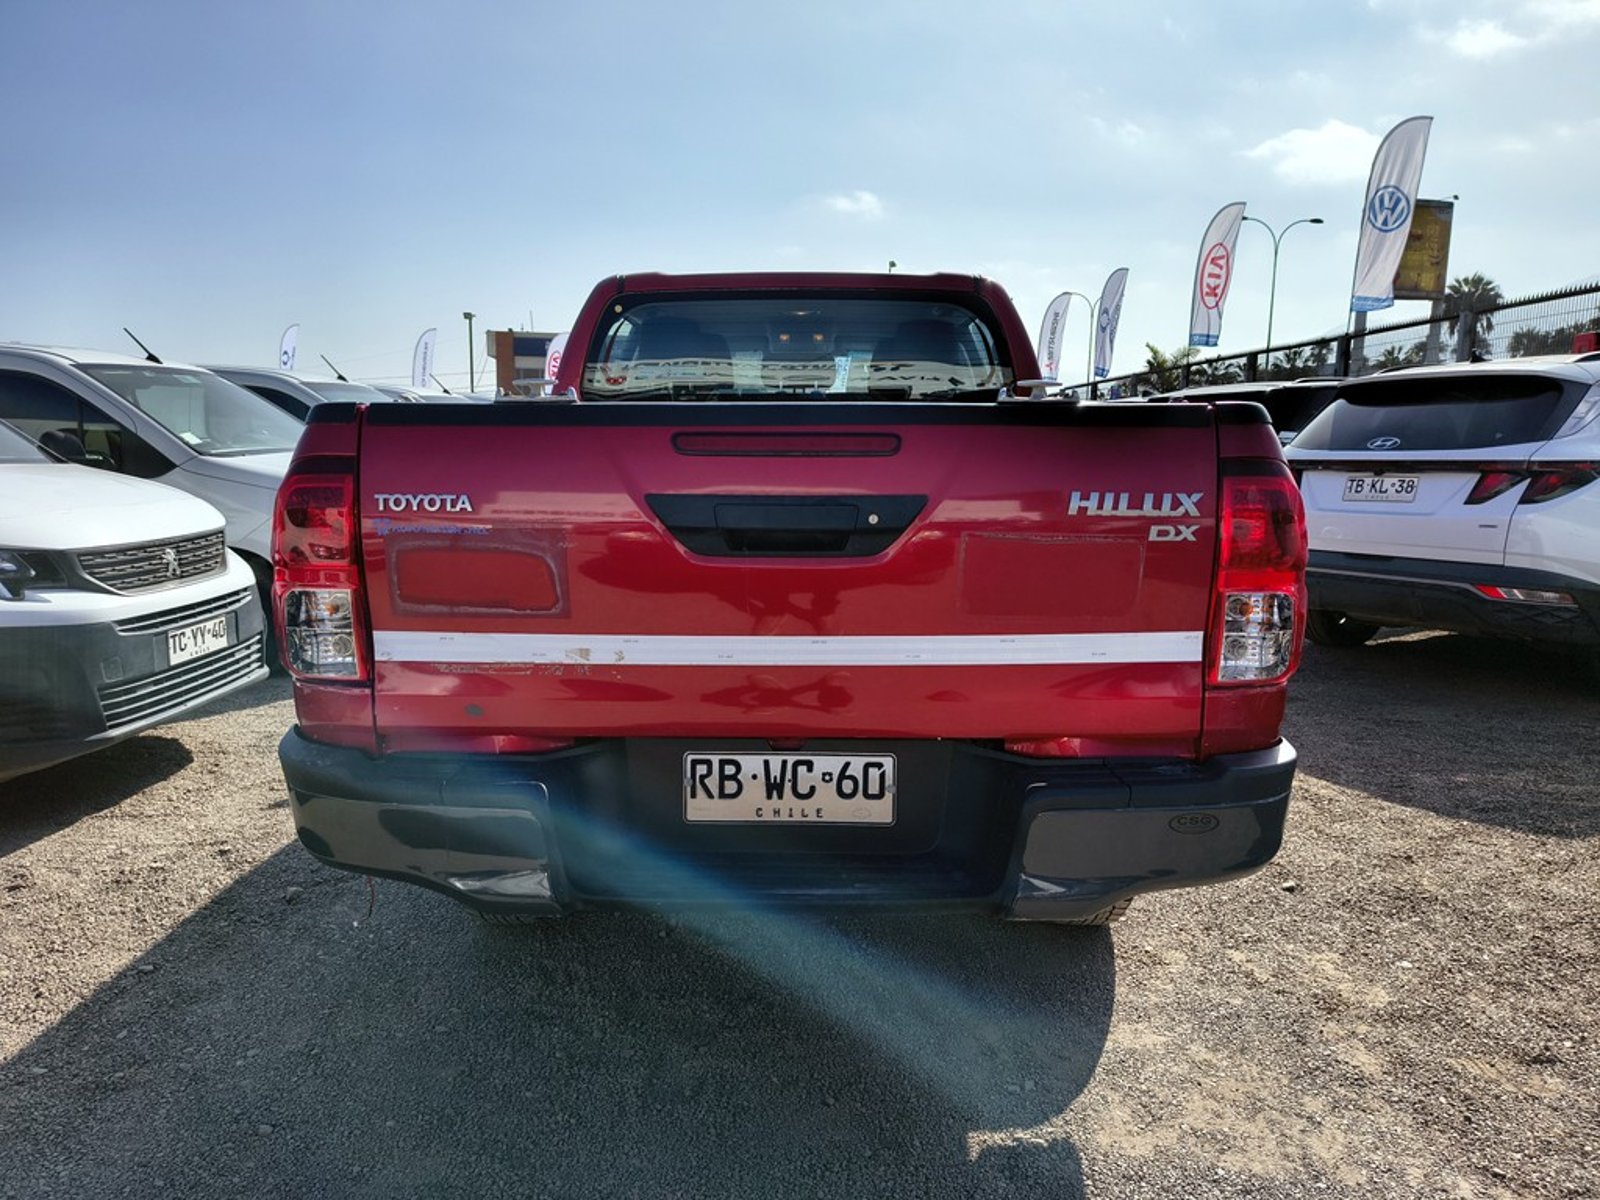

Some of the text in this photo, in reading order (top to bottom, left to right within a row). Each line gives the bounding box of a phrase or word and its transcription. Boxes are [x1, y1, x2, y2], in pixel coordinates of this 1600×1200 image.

[1205, 254, 1226, 298] KIA
[374, 494, 473, 512] TOYOTA
[1067, 491, 1204, 517] HILUX
[1148, 525, 1201, 542] DX
[755, 807, 824, 818] CHILE
